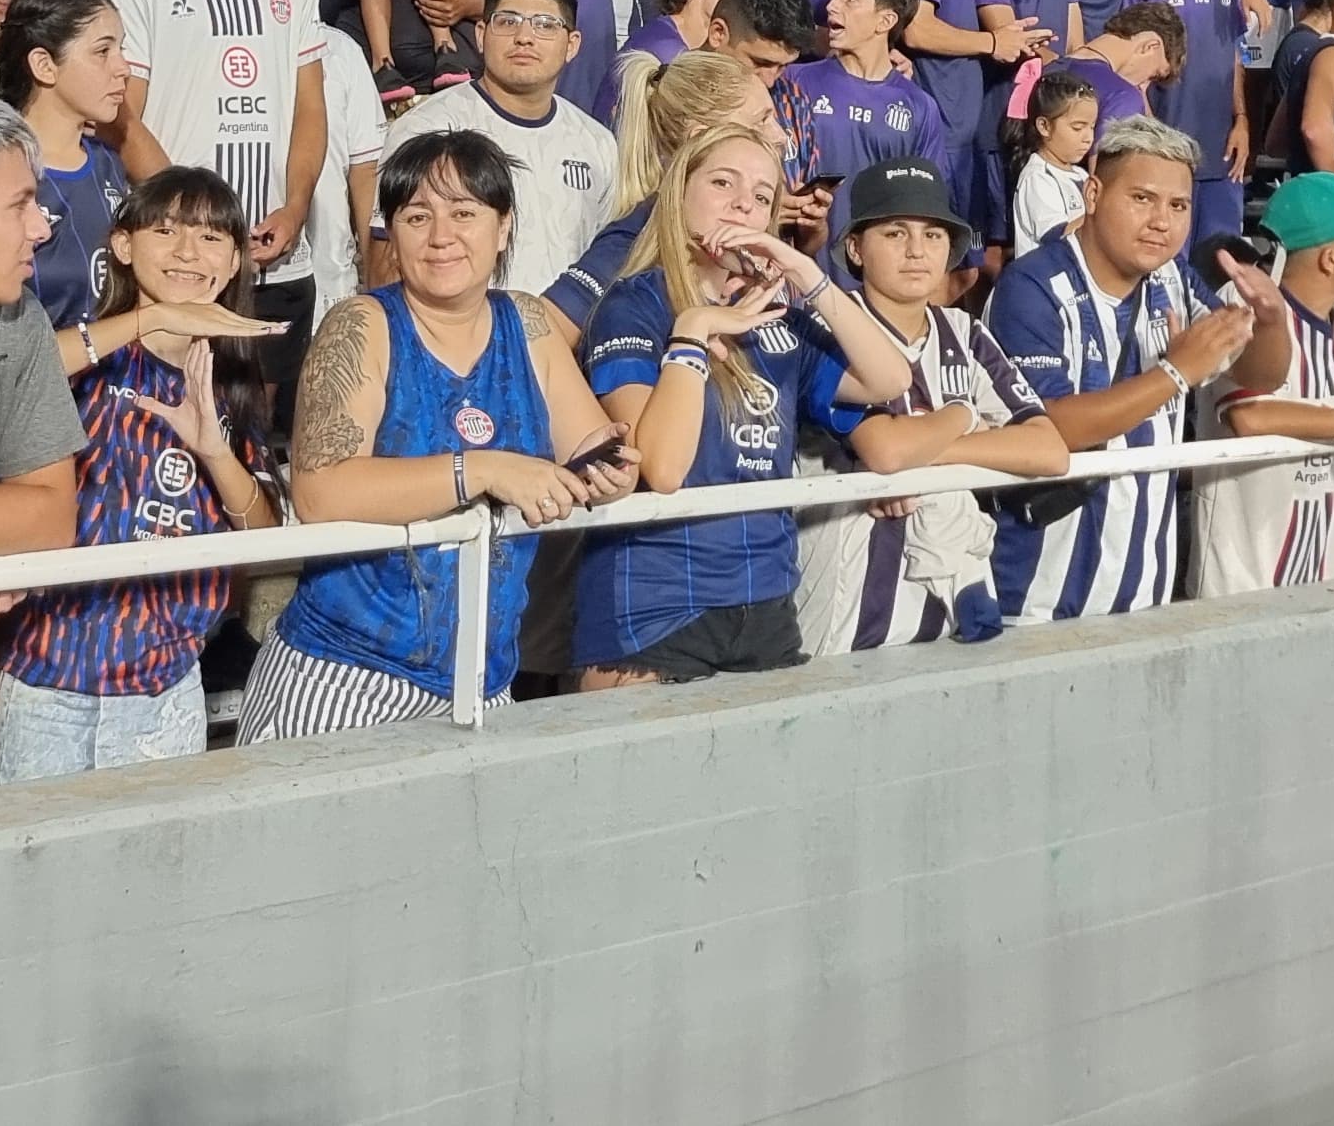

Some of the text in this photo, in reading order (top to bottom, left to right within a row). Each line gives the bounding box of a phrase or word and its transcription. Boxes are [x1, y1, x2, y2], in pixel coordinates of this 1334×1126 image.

[218, 96, 267, 115] ICBC
[848, 104, 872, 124] 126
[218, 121, 269, 140] Argentina
[1294, 470, 1330, 485] Argen
[134, 495, 196, 532] ICBC
